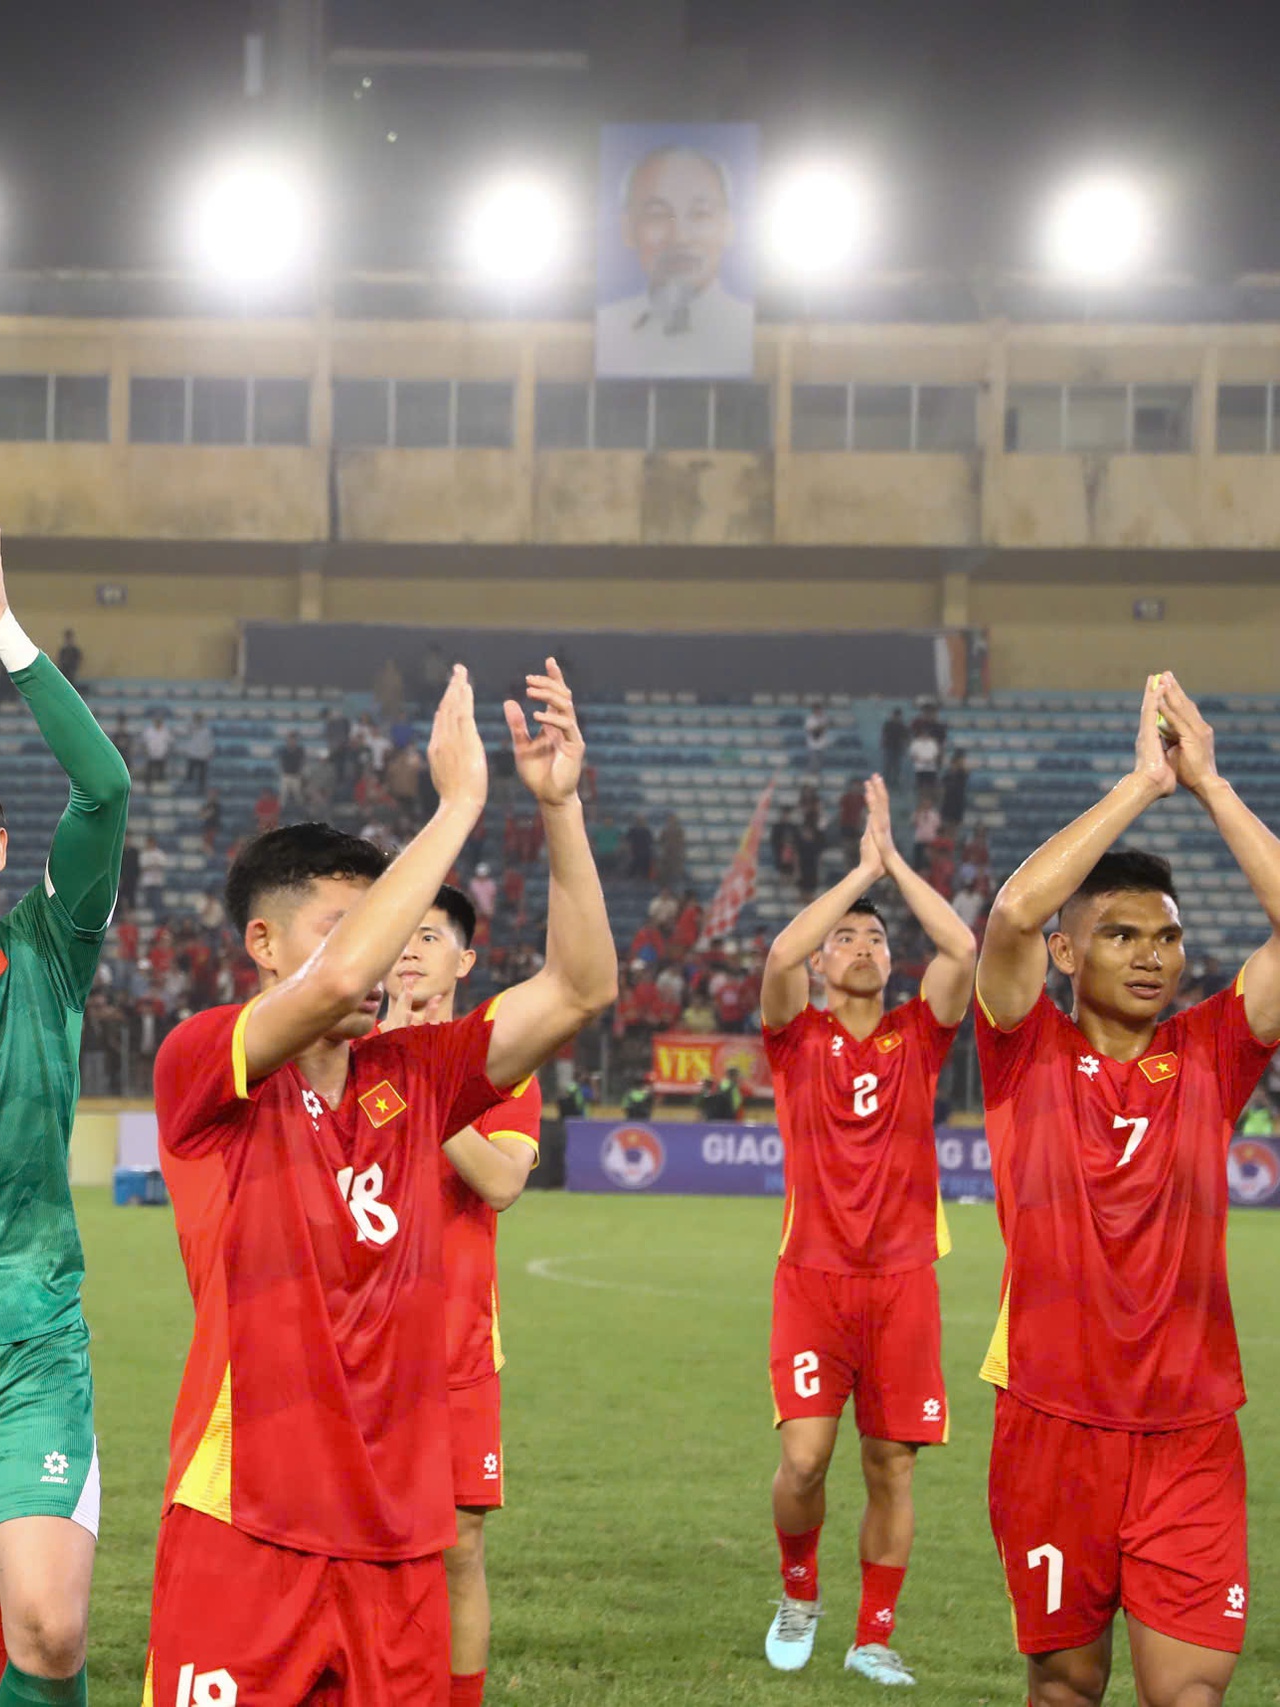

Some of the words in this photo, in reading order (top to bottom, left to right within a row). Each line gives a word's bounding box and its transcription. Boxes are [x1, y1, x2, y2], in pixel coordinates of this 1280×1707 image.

[853, 1072, 878, 1117] 2
[702, 1132, 784, 1166] GIAO
[1112, 1115, 1150, 1168] 7
[336, 1162, 399, 1246] 18
[793, 1350, 821, 1398] 2
[1026, 1543, 1064, 1615] 7
